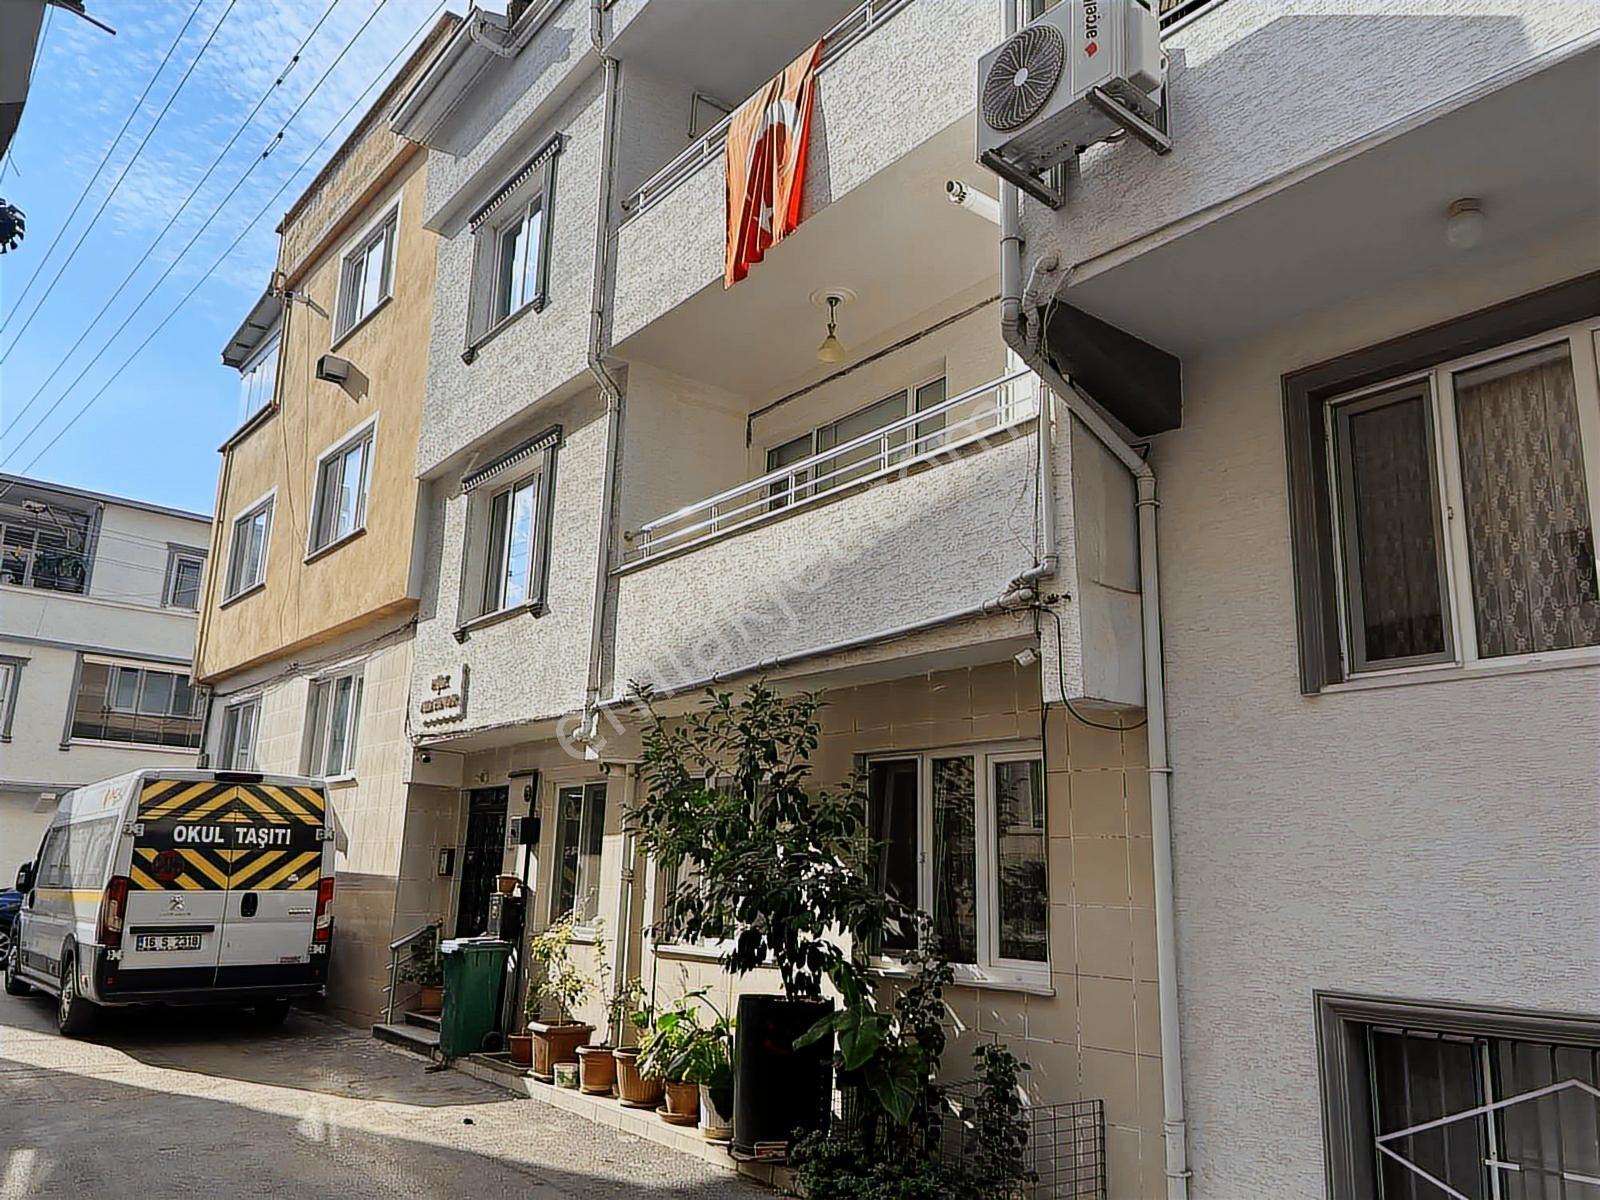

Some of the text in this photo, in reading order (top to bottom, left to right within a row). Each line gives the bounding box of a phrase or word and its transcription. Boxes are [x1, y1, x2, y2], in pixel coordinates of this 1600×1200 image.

[173, 825, 291, 848] OKUL TAŞITI
[145, 937, 156, 947] 16
[161, 937, 169, 947] S
